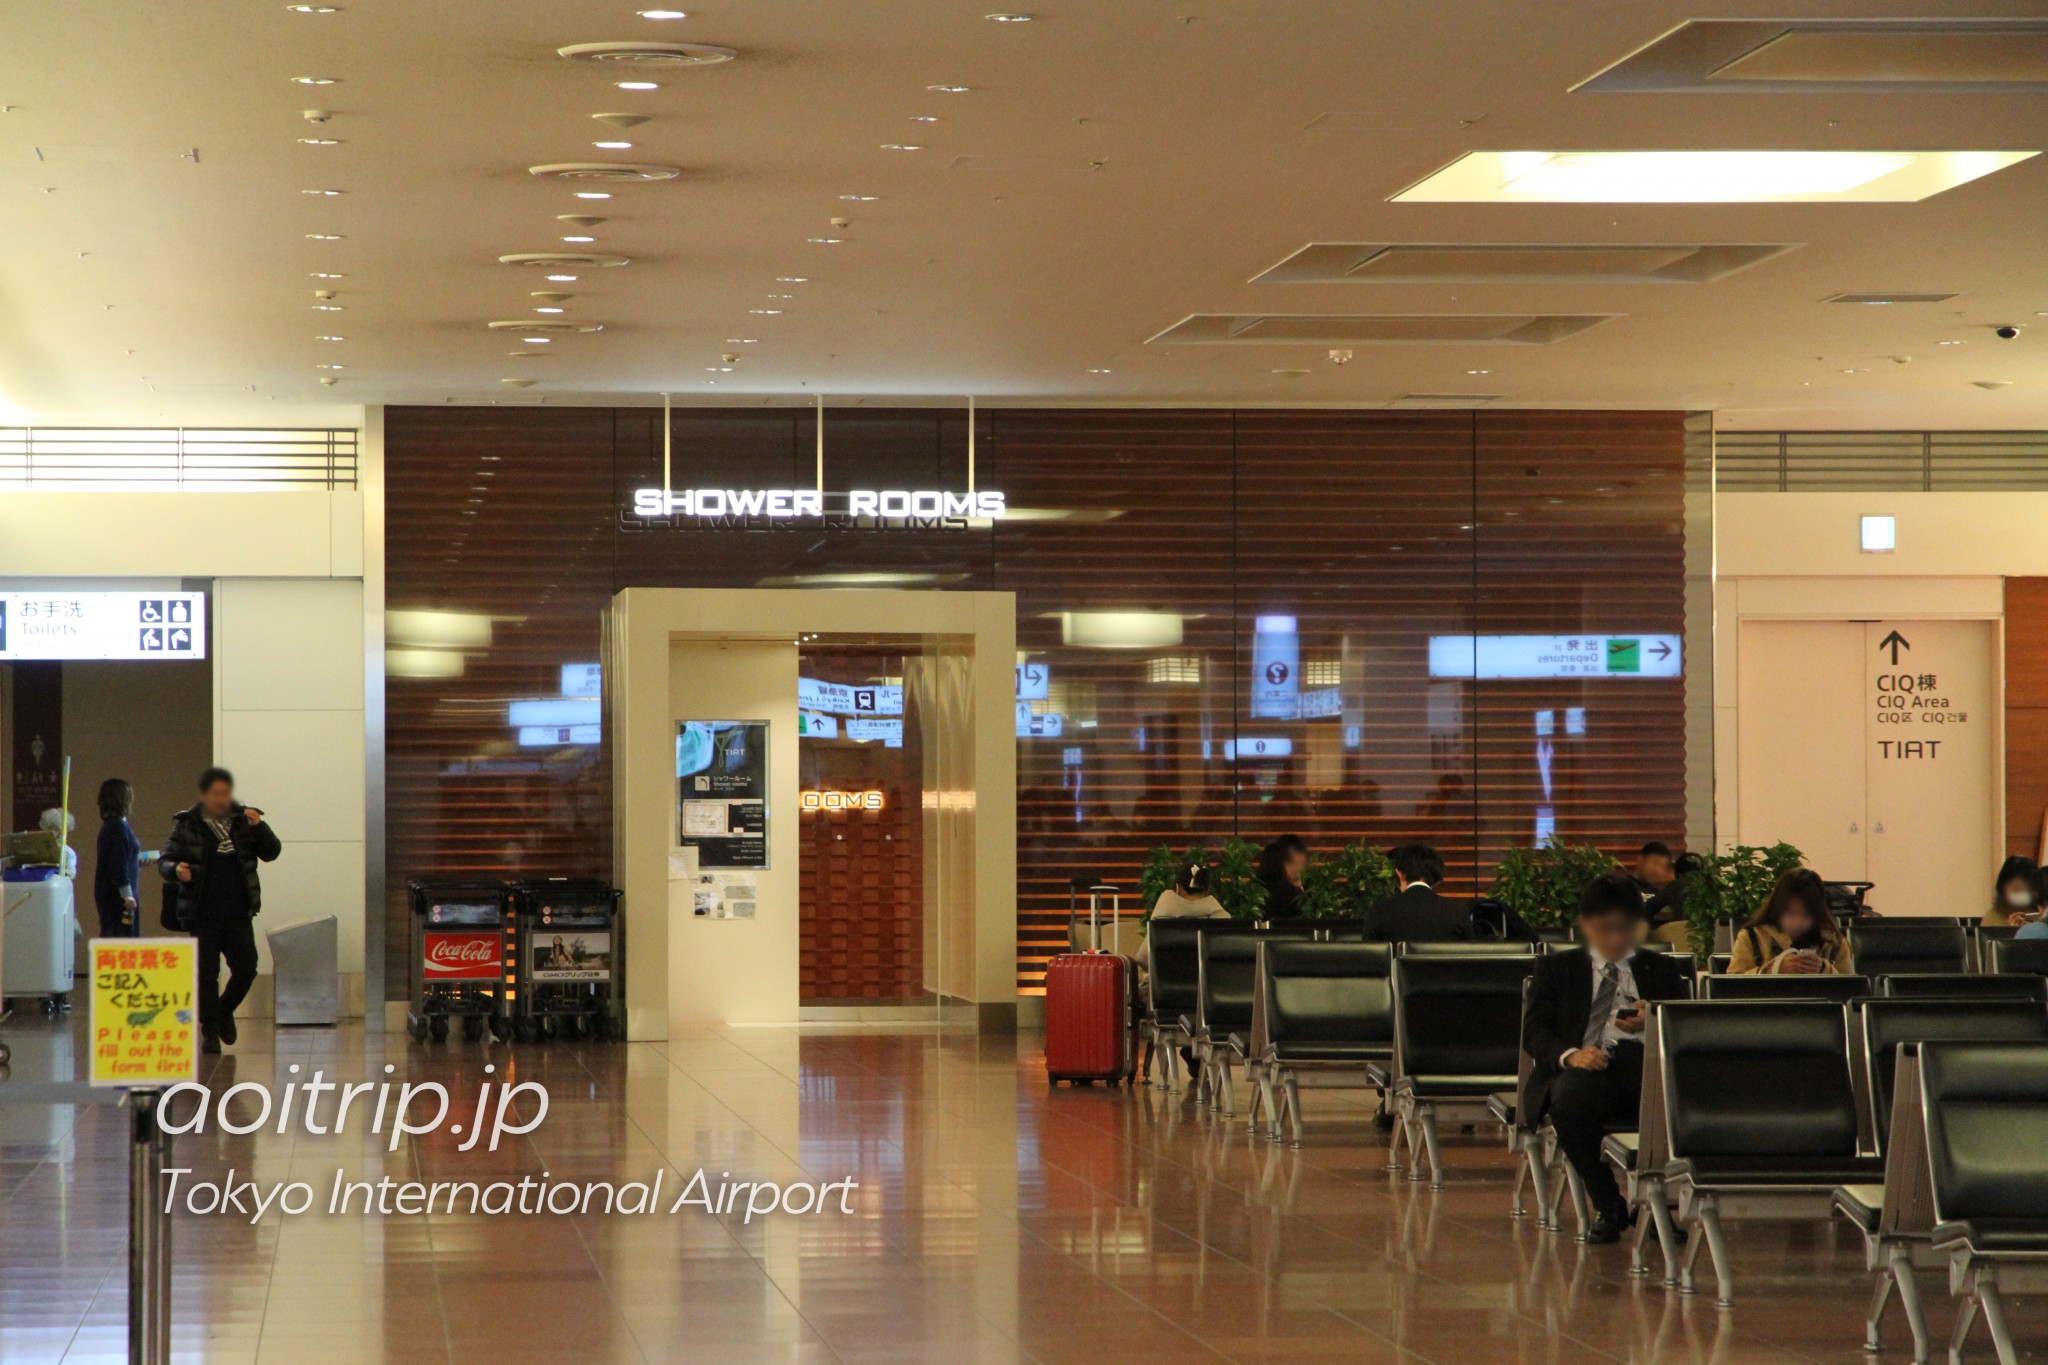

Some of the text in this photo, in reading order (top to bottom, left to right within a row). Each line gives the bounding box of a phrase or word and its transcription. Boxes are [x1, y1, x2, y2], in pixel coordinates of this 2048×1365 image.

[634, 489, 1006, 518] SHOWER ROOMS
[20, 600, 84, 618] お手洗
[20, 622, 77, 636] Toilets
[1877, 674, 1937, 694] CIQ棟
[1877, 695, 1950, 710] CIQ Area
[1877, 740, 1942, 759] TIAT
[97, 973, 148, 990] ご記入
[128, 1044, 152, 1057] out
[159, 1044, 183, 1057] the
[112, 1060, 191, 1073] form first
